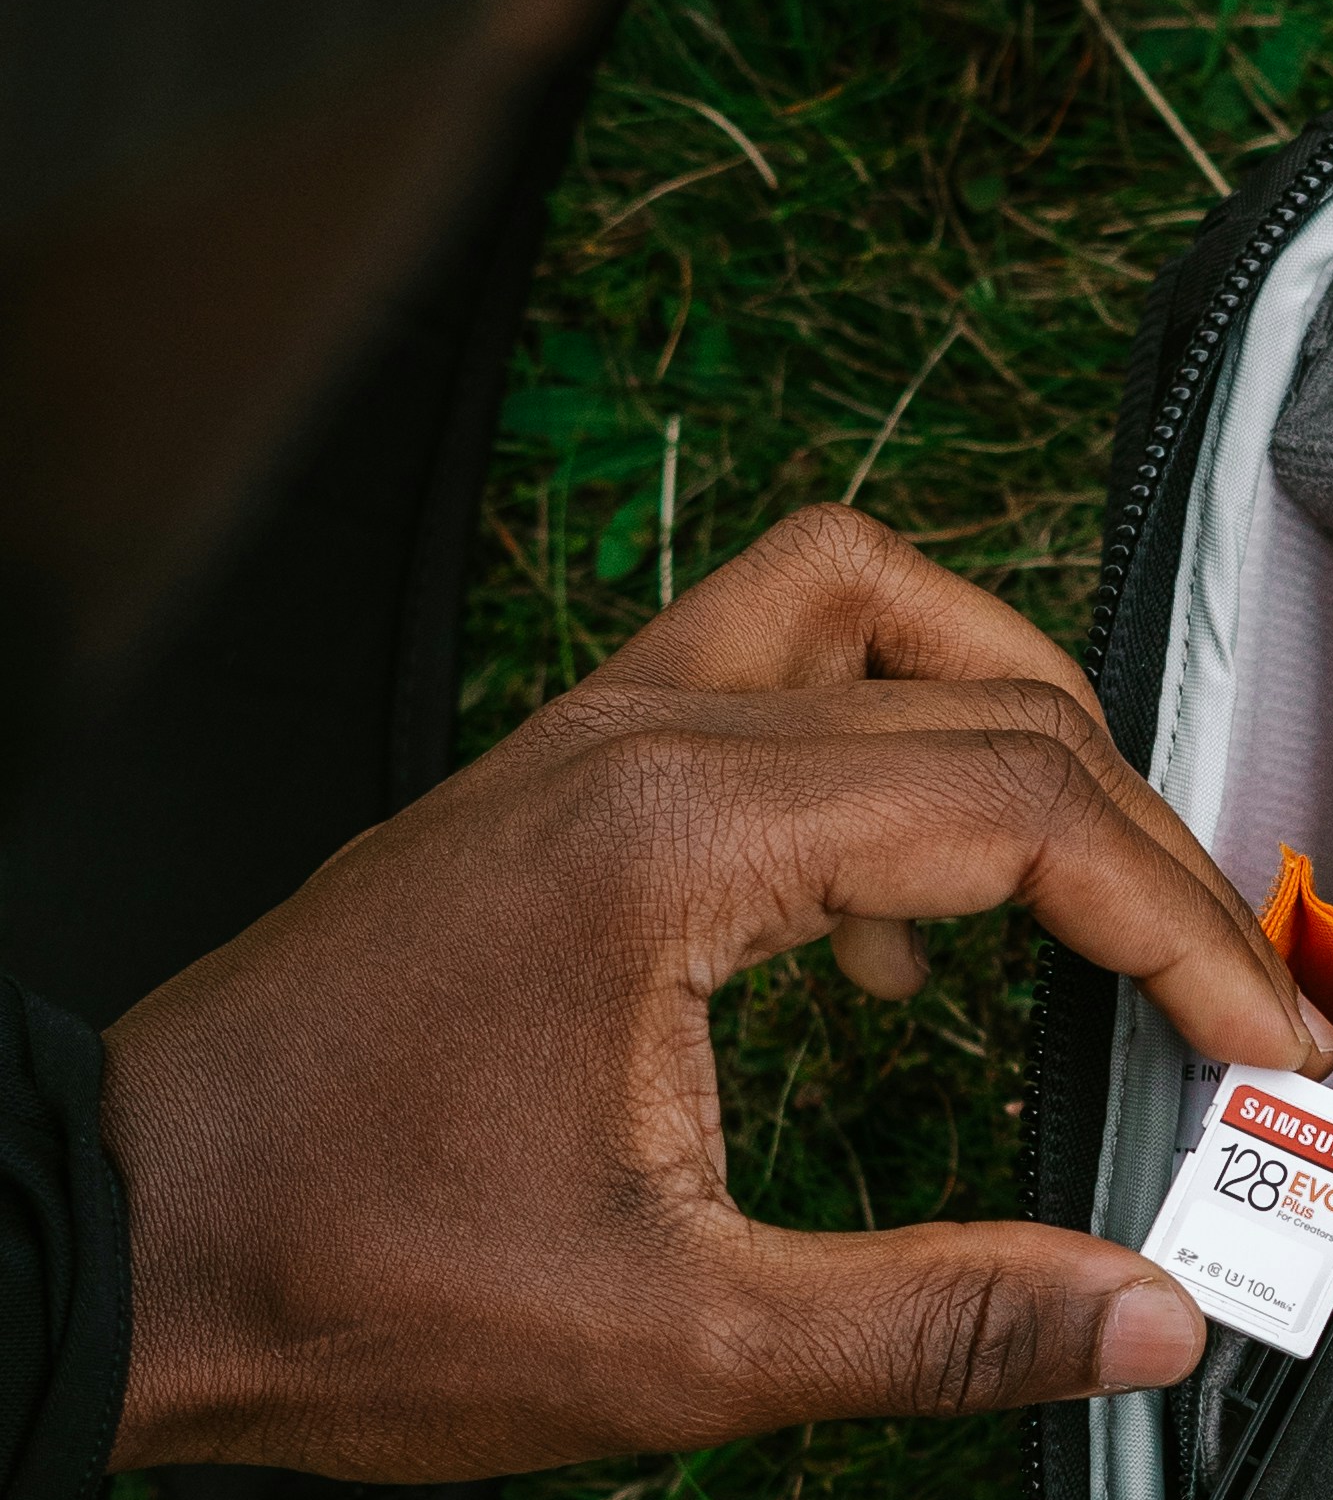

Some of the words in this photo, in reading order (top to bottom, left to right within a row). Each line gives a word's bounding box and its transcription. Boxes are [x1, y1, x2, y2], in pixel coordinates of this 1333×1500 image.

[1201, 1065, 1221, 1083] IN
[1214, 1143, 1287, 1211] 128
[1276, 1209, 1292, 1223] For
[1281, 1196, 1315, 1220] Plus
[1247, 1279, 1275, 1302] 100
